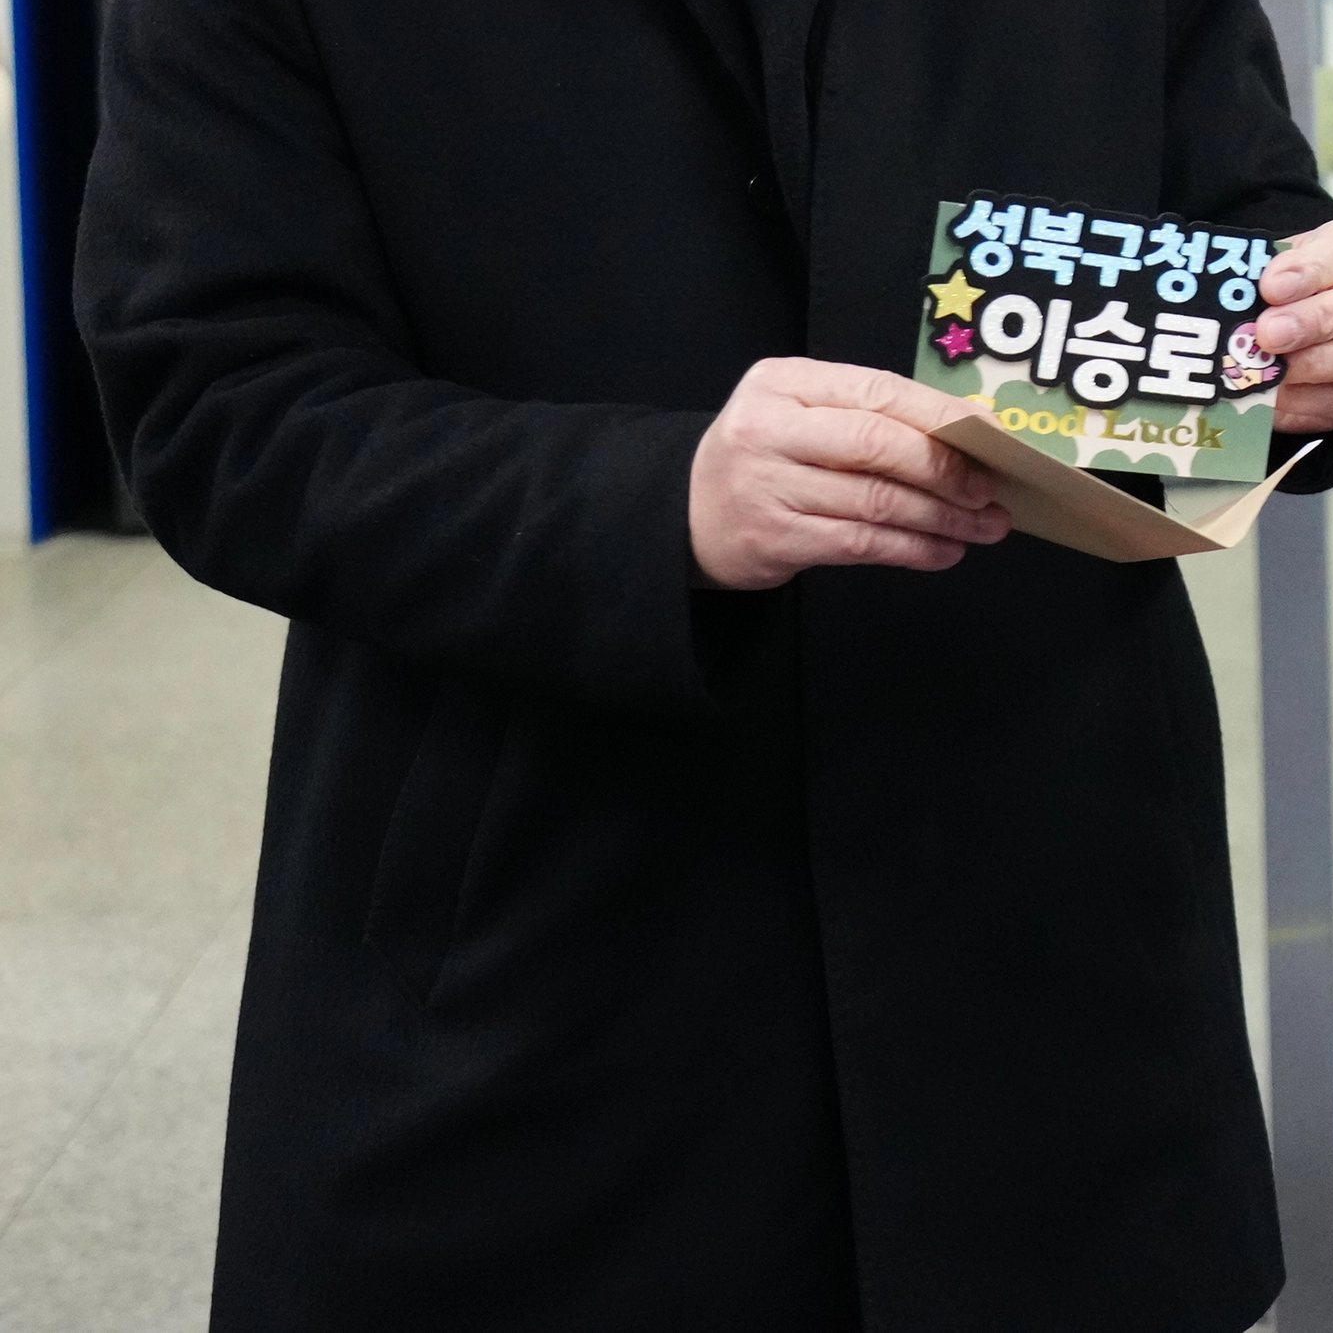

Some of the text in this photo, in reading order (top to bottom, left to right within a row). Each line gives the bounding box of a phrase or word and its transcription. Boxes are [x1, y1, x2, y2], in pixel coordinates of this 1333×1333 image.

[954, 199, 1270, 312] 성북구청장
[979, 293, 1221, 403] 이승로
[1100, 409, 1226, 450] Luck
